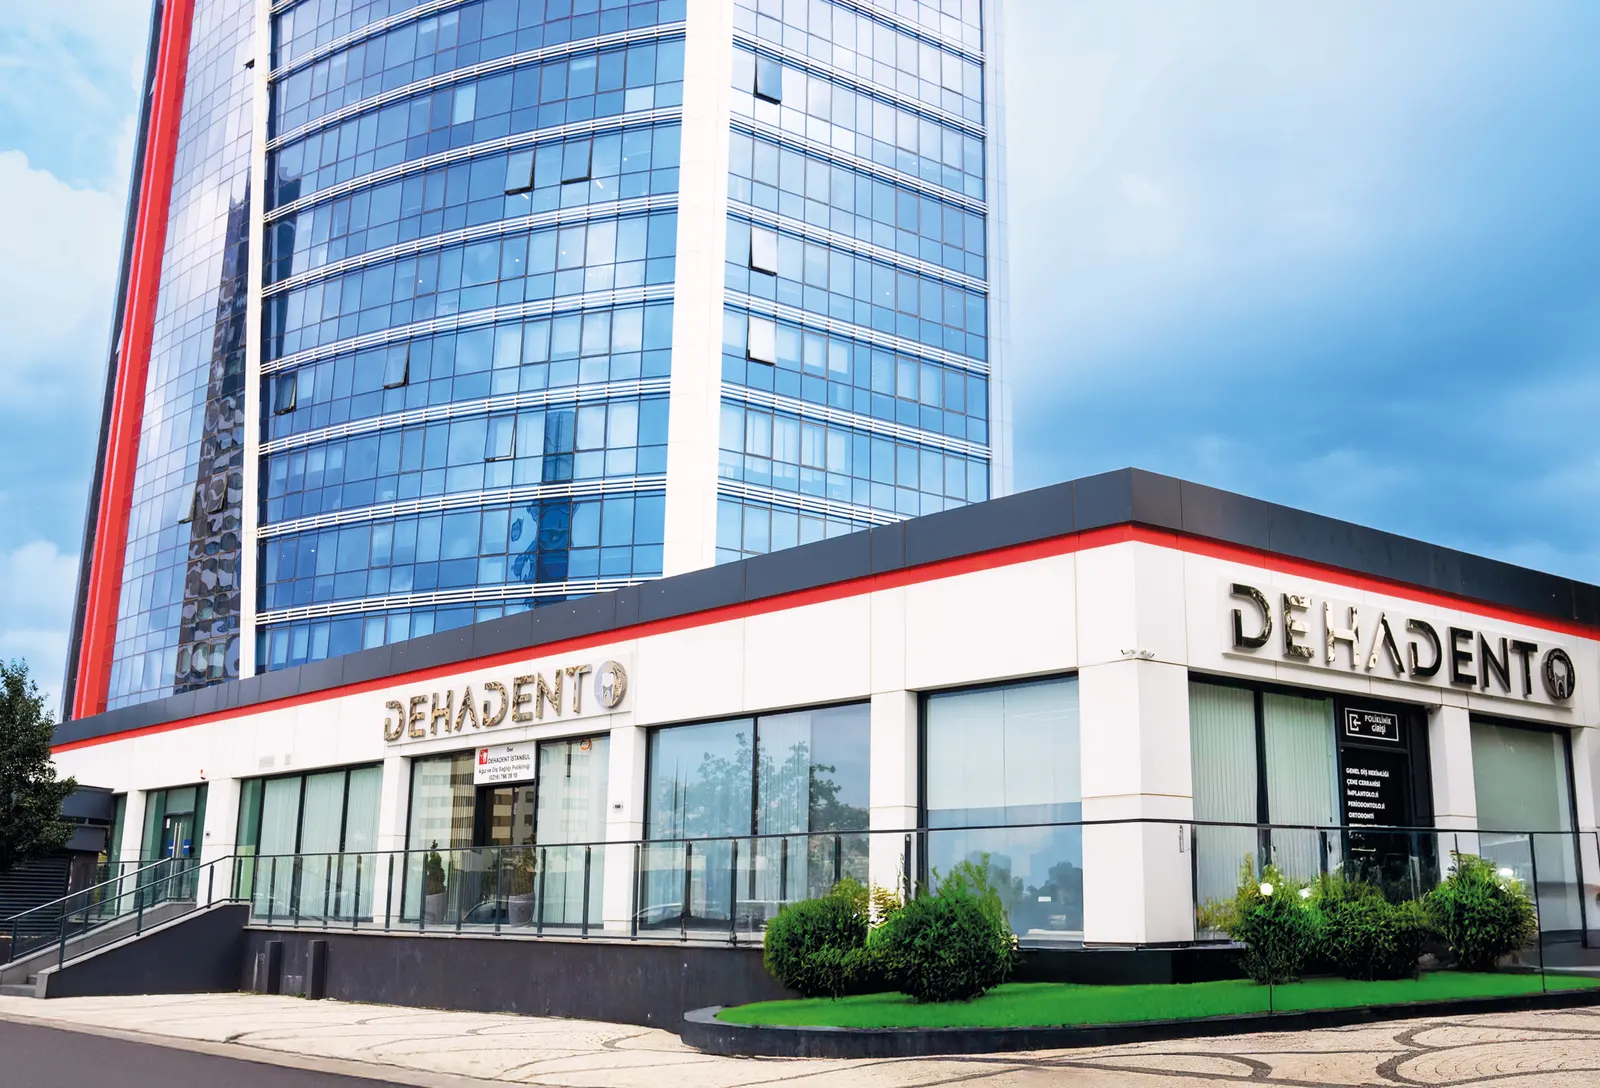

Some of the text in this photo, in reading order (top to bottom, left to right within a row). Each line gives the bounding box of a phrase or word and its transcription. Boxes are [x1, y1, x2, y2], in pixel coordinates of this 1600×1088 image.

[1230, 582, 1538, 697] DEHADENT
[384, 664, 592, 741] DEHADENT
[1364, 714, 1391, 725] POLİKLİNİK
[1371, 723, 1386, 735] GİRİŞİ
[488, 756, 510, 764] DEHADENT
[1346, 767, 1390, 778] GENEL DİŞ HEKİMLİĞİ
[1346, 778, 1359, 786] ÇENE
[1347, 788, 1379, 798] İMPLANTOLOJİ
[1347, 800, 1385, 810] PERİODONTOLOJİ
[1348, 811, 1375, 819] ORTODONTİ
